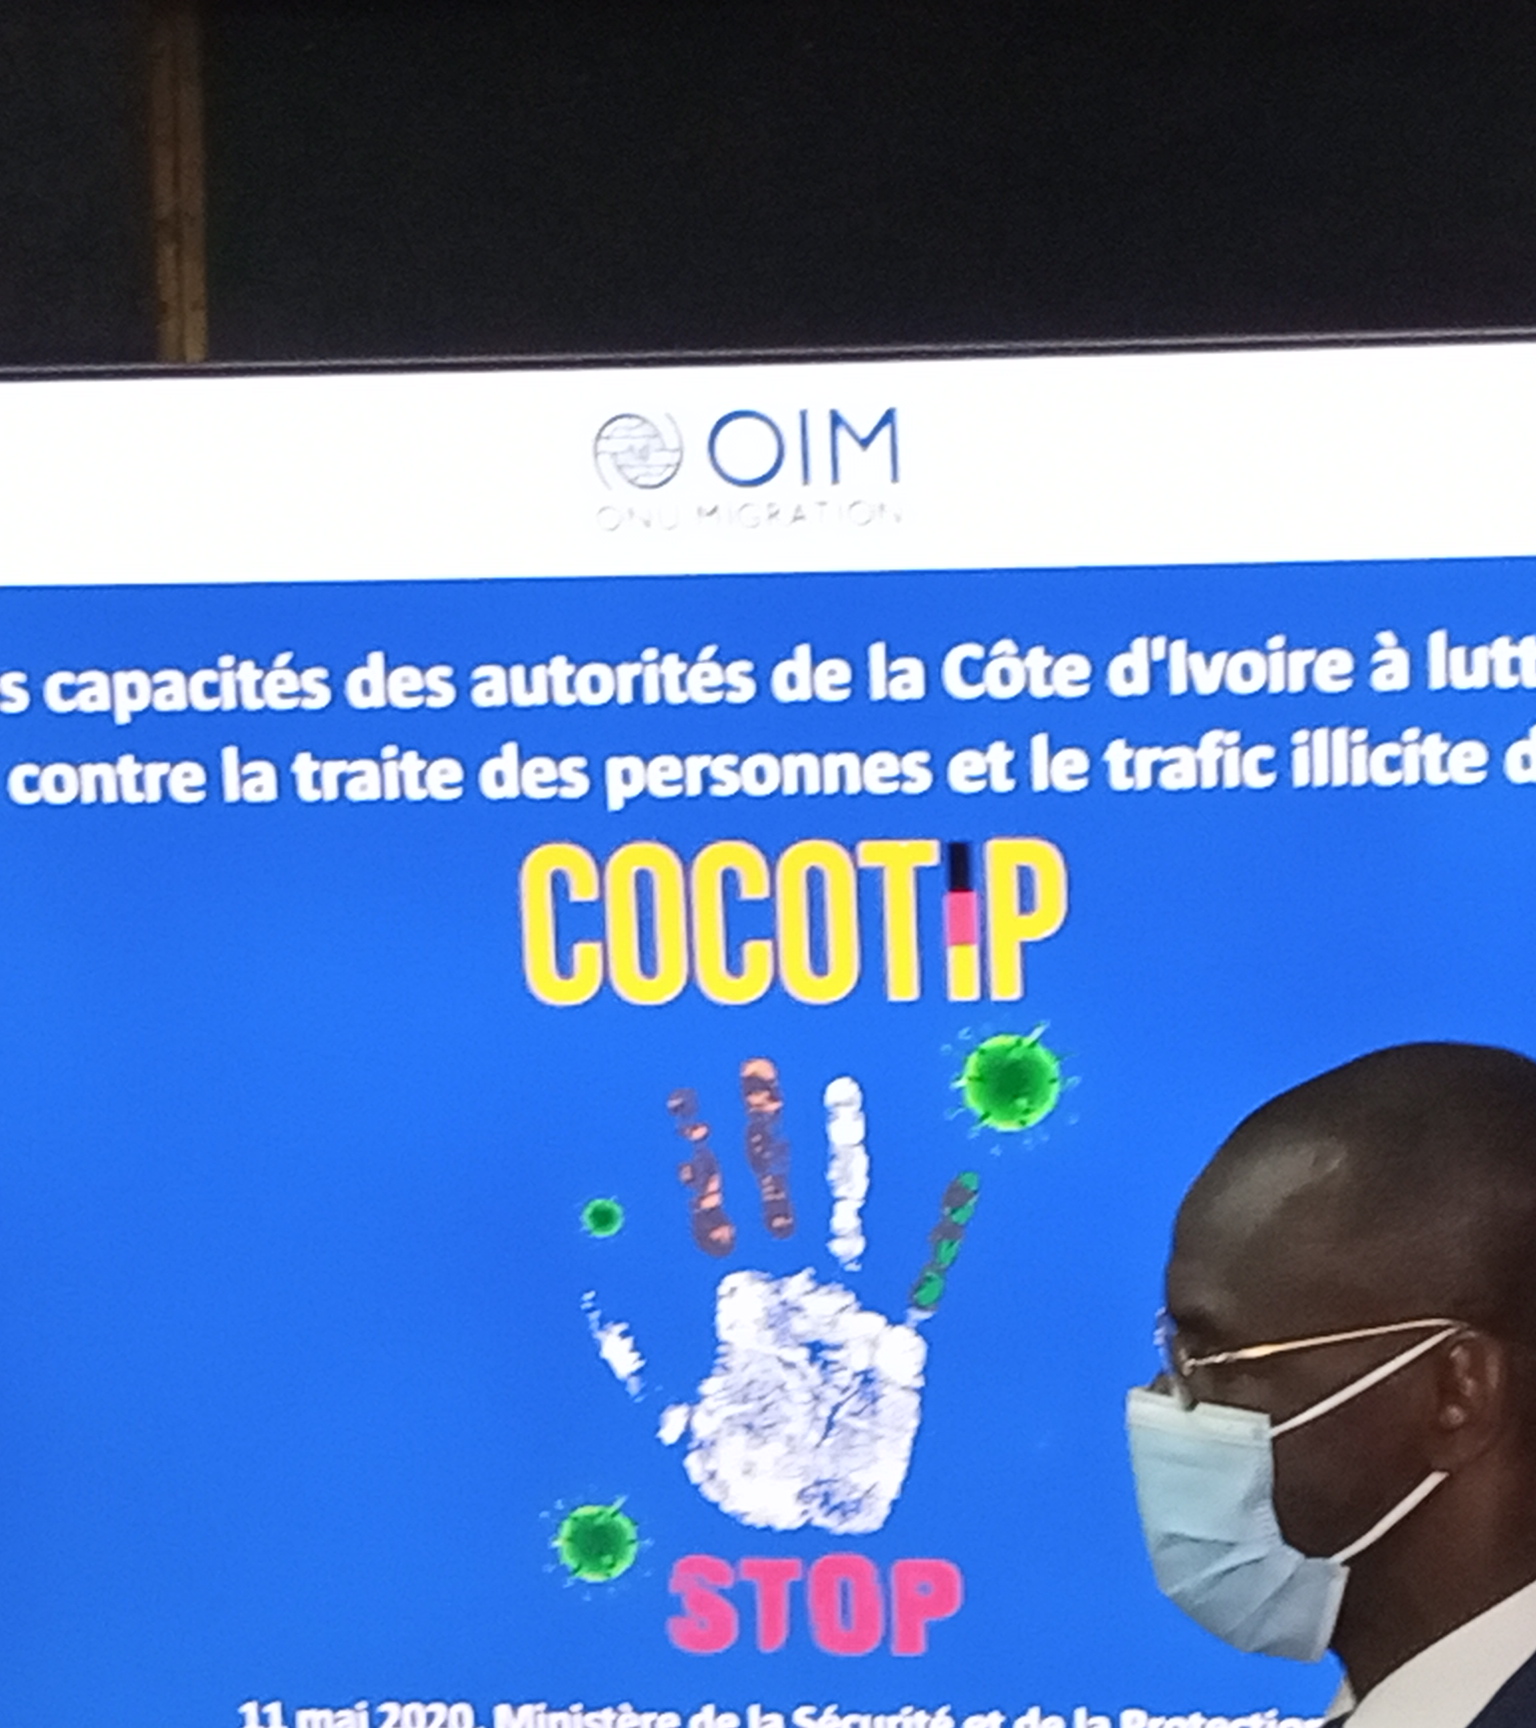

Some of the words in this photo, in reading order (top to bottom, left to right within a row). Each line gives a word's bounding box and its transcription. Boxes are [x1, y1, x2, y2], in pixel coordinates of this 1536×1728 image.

[707, 406, 901, 488] OIM
[596, 505, 681, 532] ONU
[696, 500, 904, 530] MIGRATION
[44, 652, 331, 724] capacités
[346, 651, 456, 708] des
[471, 645, 756, 707] autorités
[772, 644, 851, 702] de
[869, 642, 925, 700] la
[942, 639, 1091, 699] Côte
[1107, 635, 1353, 696] d'Ivoire
[1371, 631, 1409, 691] à
[8, 754, 206, 804] contre
[222, 746, 277, 802] la
[291, 745, 463, 801] traite
[479, 742, 589, 799] des
[606, 751, 932, 810] personnes
[948, 741, 1015, 793] et
[1031, 733, 1089, 791] le
[1103, 729, 1276, 790] trafic
[1292, 727, 1488, 787] illicite
[520, 837, 1067, 1006] COCOTIP
[667, 1552, 963, 1656] STOP
